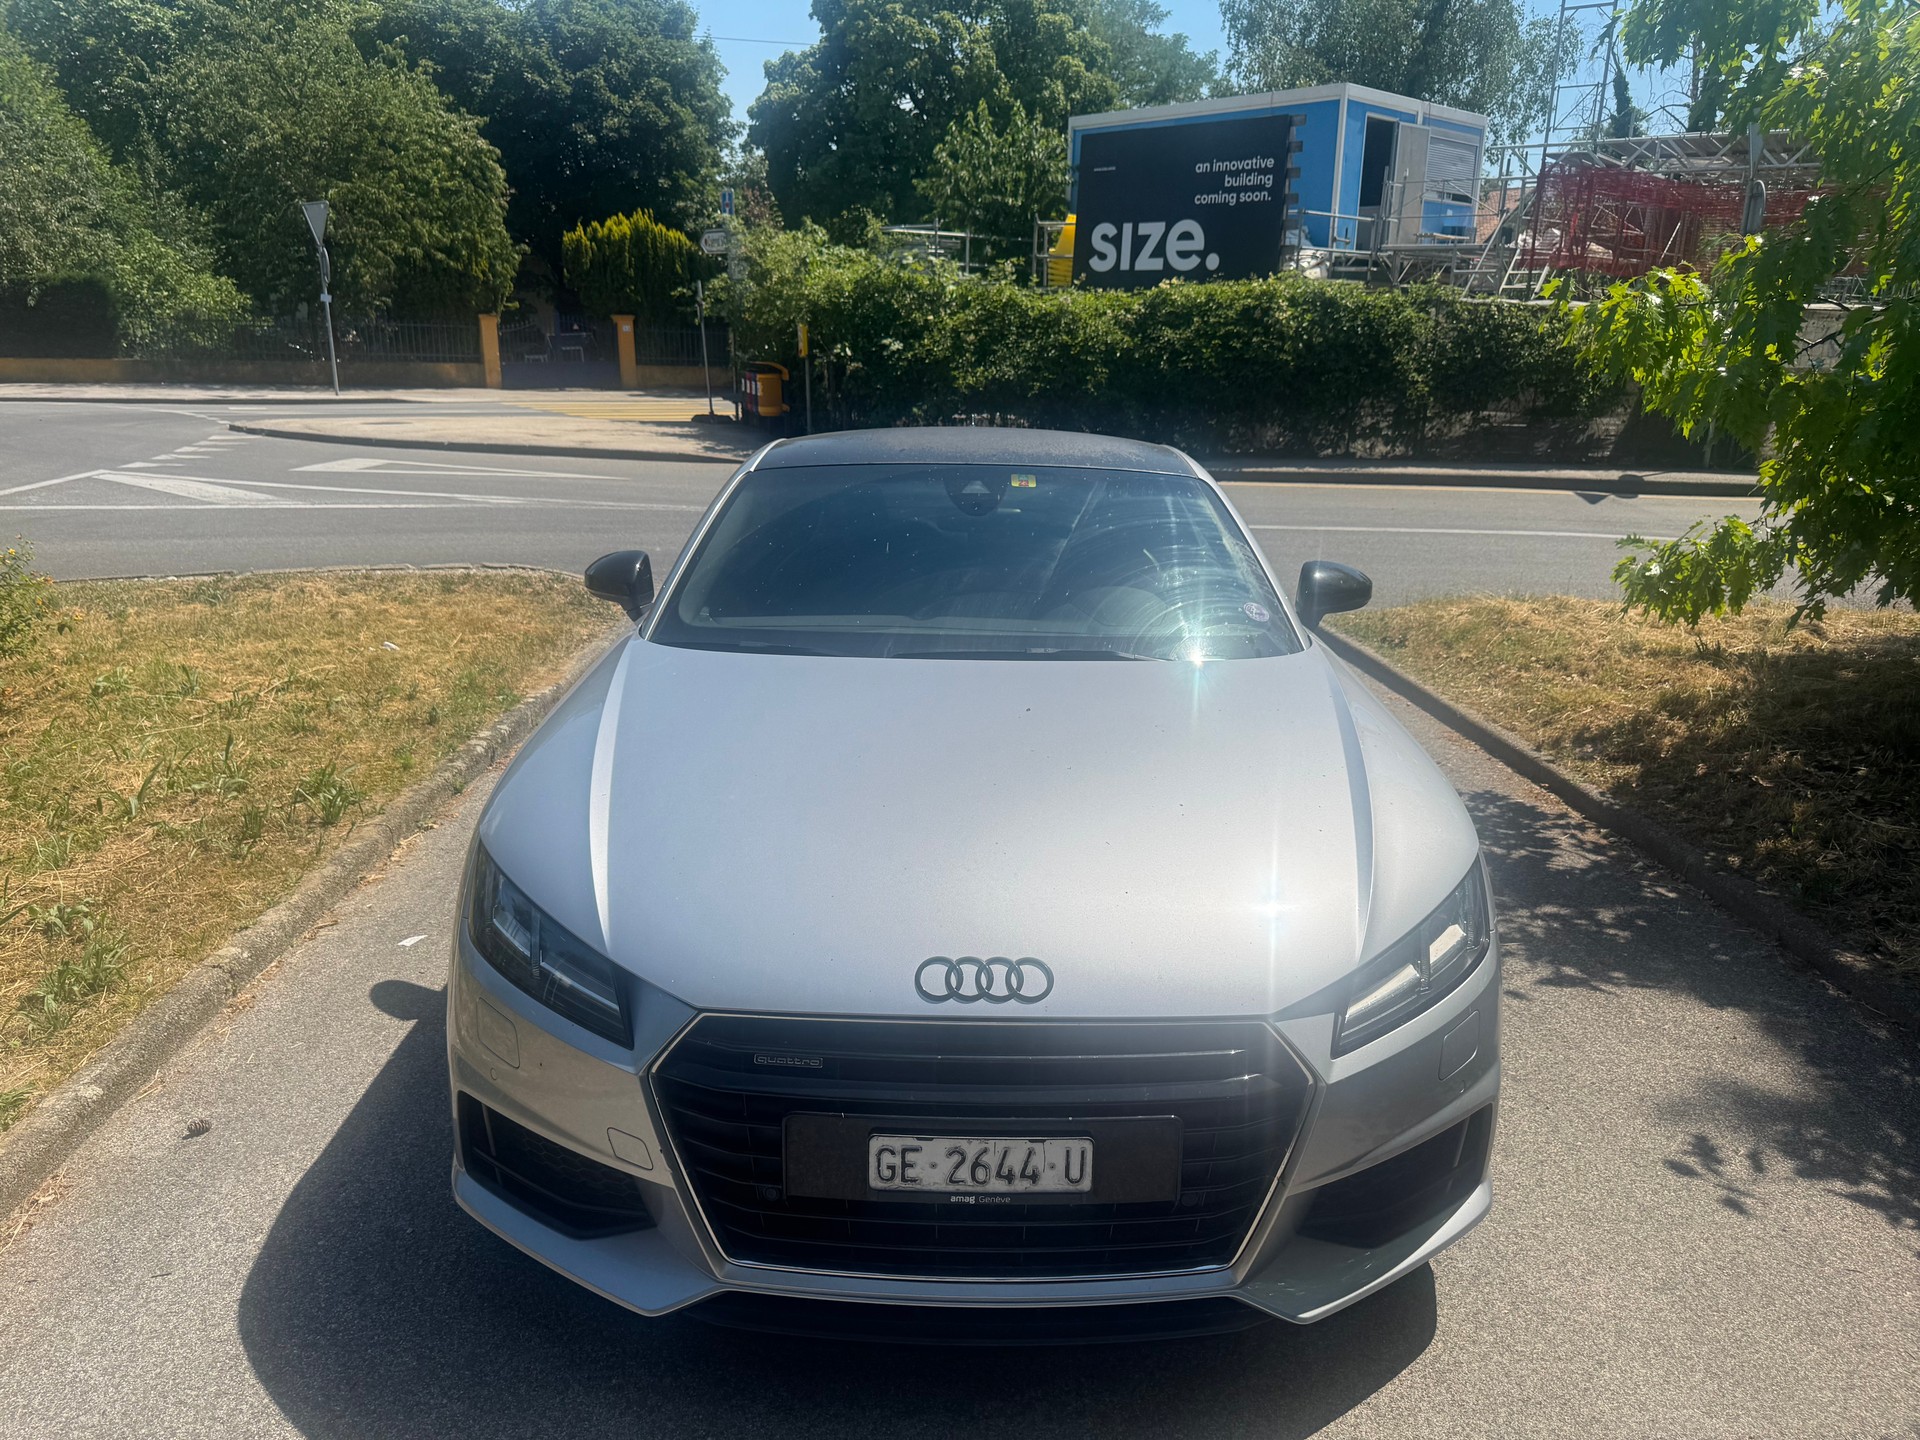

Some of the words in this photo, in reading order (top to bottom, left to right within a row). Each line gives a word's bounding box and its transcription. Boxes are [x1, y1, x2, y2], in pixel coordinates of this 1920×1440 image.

[1195, 161, 1210, 174] an
[1212, 155, 1275, 173] innovative
[1224, 173, 1273, 188] building
[1194, 190, 1237, 206] coming
[1239, 190, 1272, 202] soon.
[757, 1056, 820, 1065] quattro
[875, 1146, 922, 1183] GE
[946, 1146, 1040, 1186] 2644
[1064, 1147, 1086, 1185] U
[950, 1195, 976, 1204] amag
